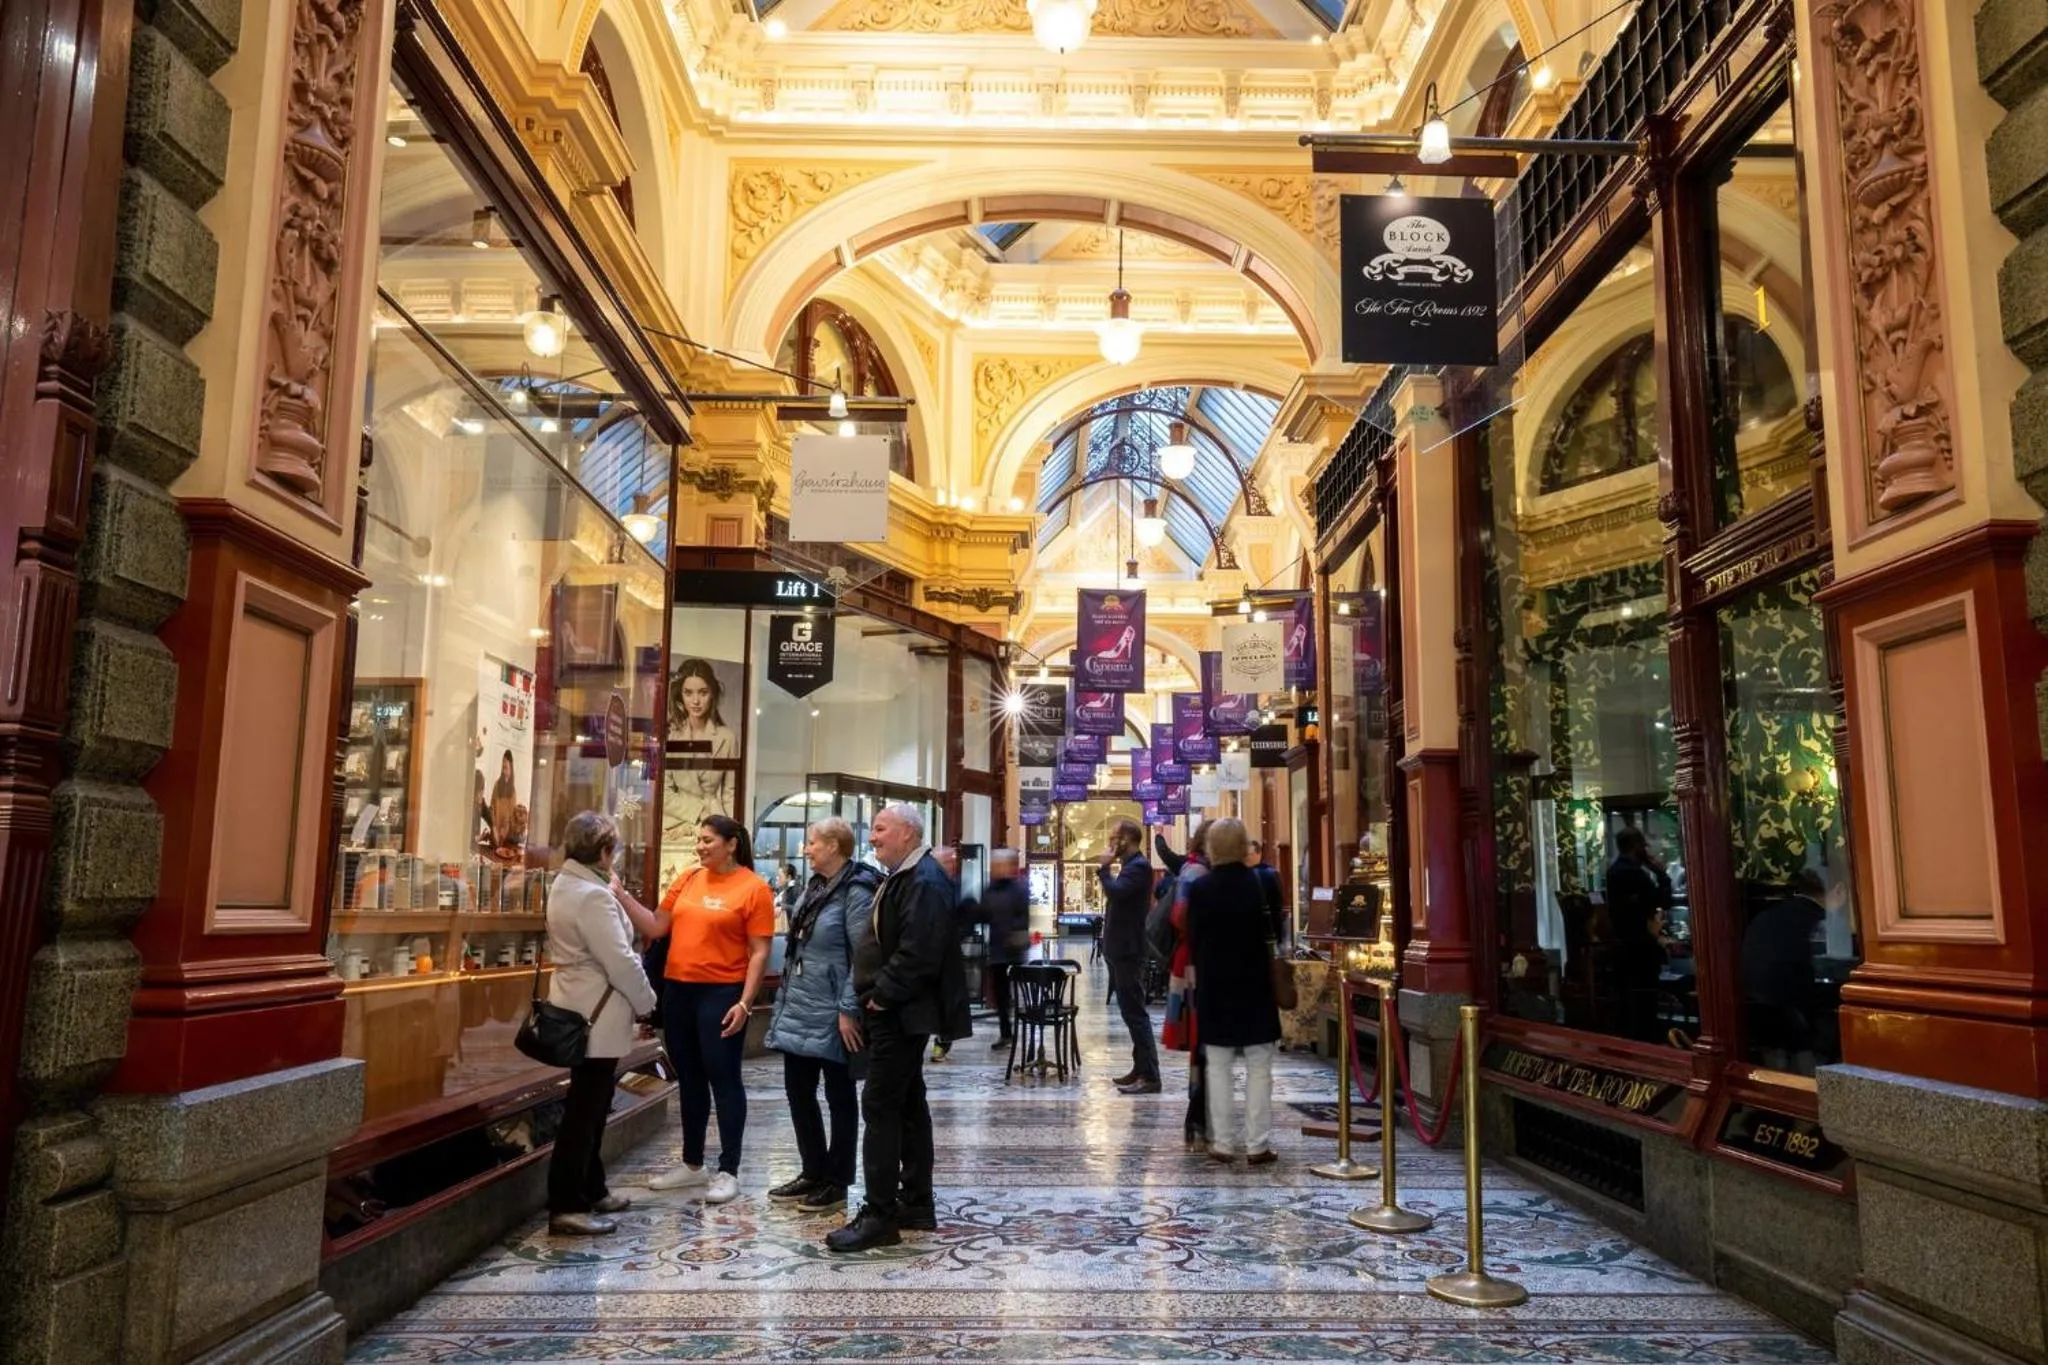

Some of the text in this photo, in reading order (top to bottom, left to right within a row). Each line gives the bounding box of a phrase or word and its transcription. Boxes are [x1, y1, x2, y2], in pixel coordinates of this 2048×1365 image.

[1389, 231, 1446, 242] BLOCK
[1355, 297, 1487, 318] The Tea Rooms 1892
[776, 581, 820, 598] Lift 1
[780, 642, 823, 652] GRACE
[1567, 1068, 1597, 1096] TEA
[1596, 1074, 1658, 1111] ROOMS
[1784, 1131, 1819, 1158] 1892
